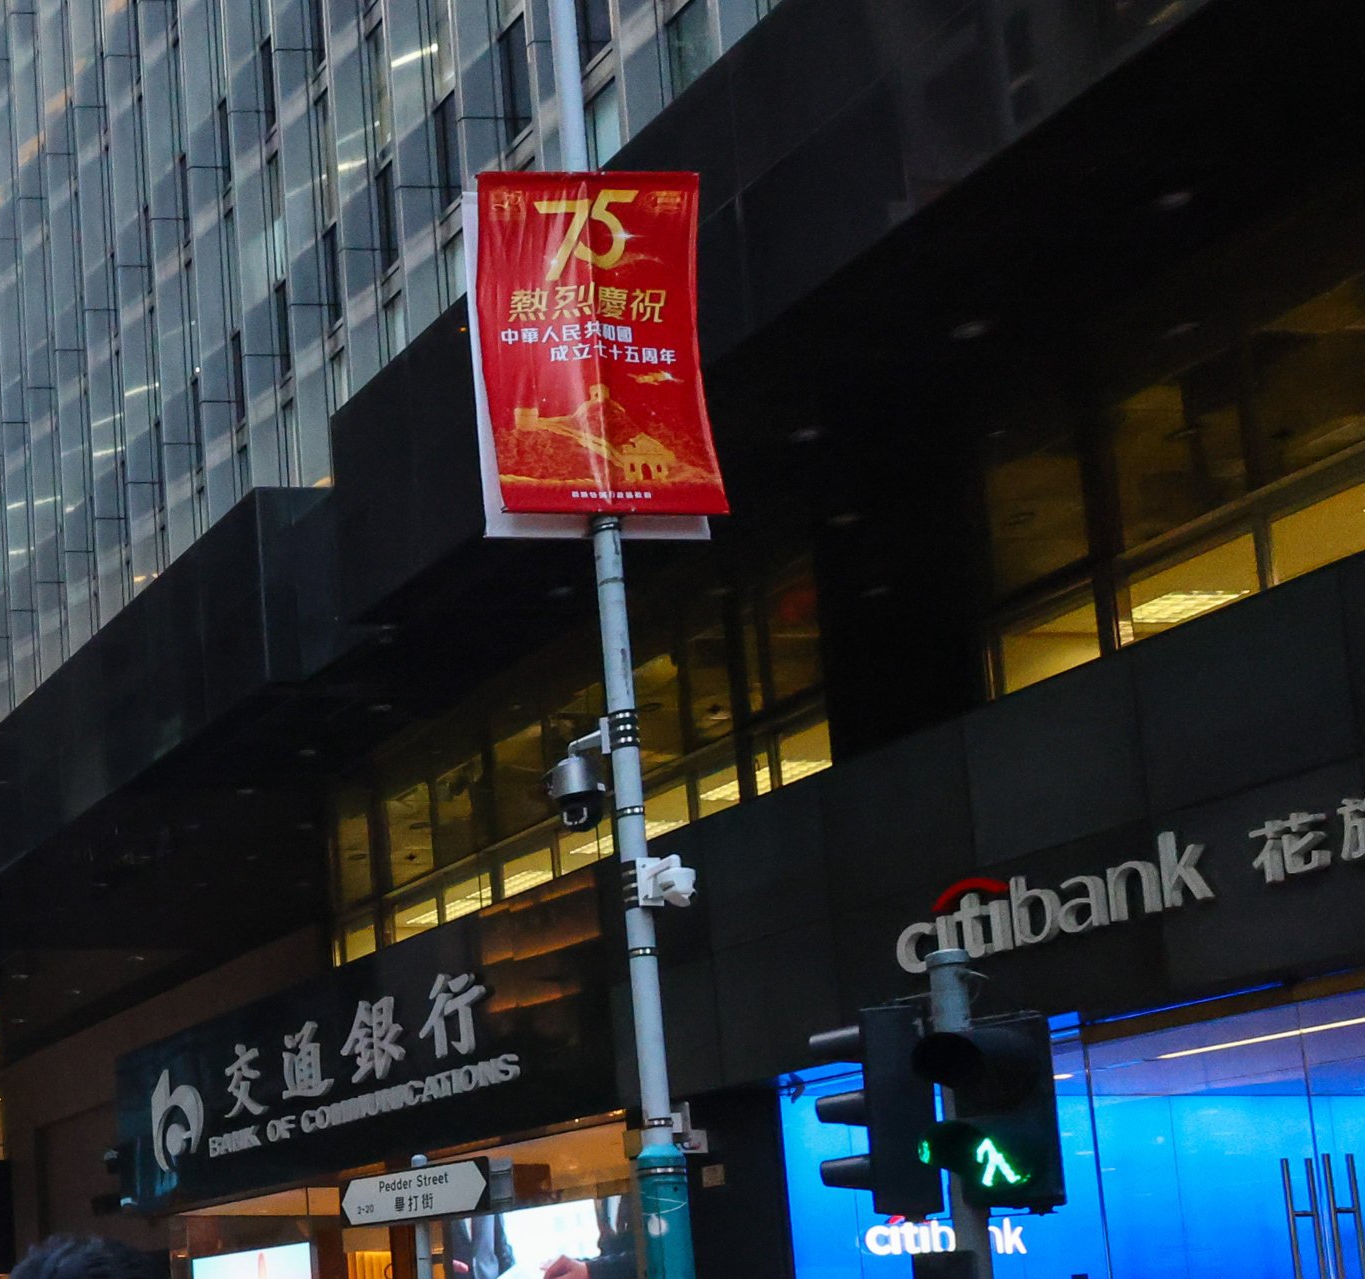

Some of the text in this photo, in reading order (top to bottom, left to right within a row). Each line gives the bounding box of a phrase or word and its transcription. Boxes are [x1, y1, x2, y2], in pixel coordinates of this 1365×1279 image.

[534, 189, 639, 281] 75
[507, 281, 666, 322] 熱烈慶祝
[501, 321, 632, 345] 中華人民共和國
[550, 340, 676, 364] 成立七十五周年
[896, 830, 1216, 974] citibank
[224, 973, 486, 1118] 交通銀行
[209, 1053, 521, 1158] BANK OF COMMUNICATIONS
[378, 1171, 449, 1193] Pedder Street
[394, 1192, 434, 1212] 畢打街
[864, 1217, 1028, 1256] citibnk
